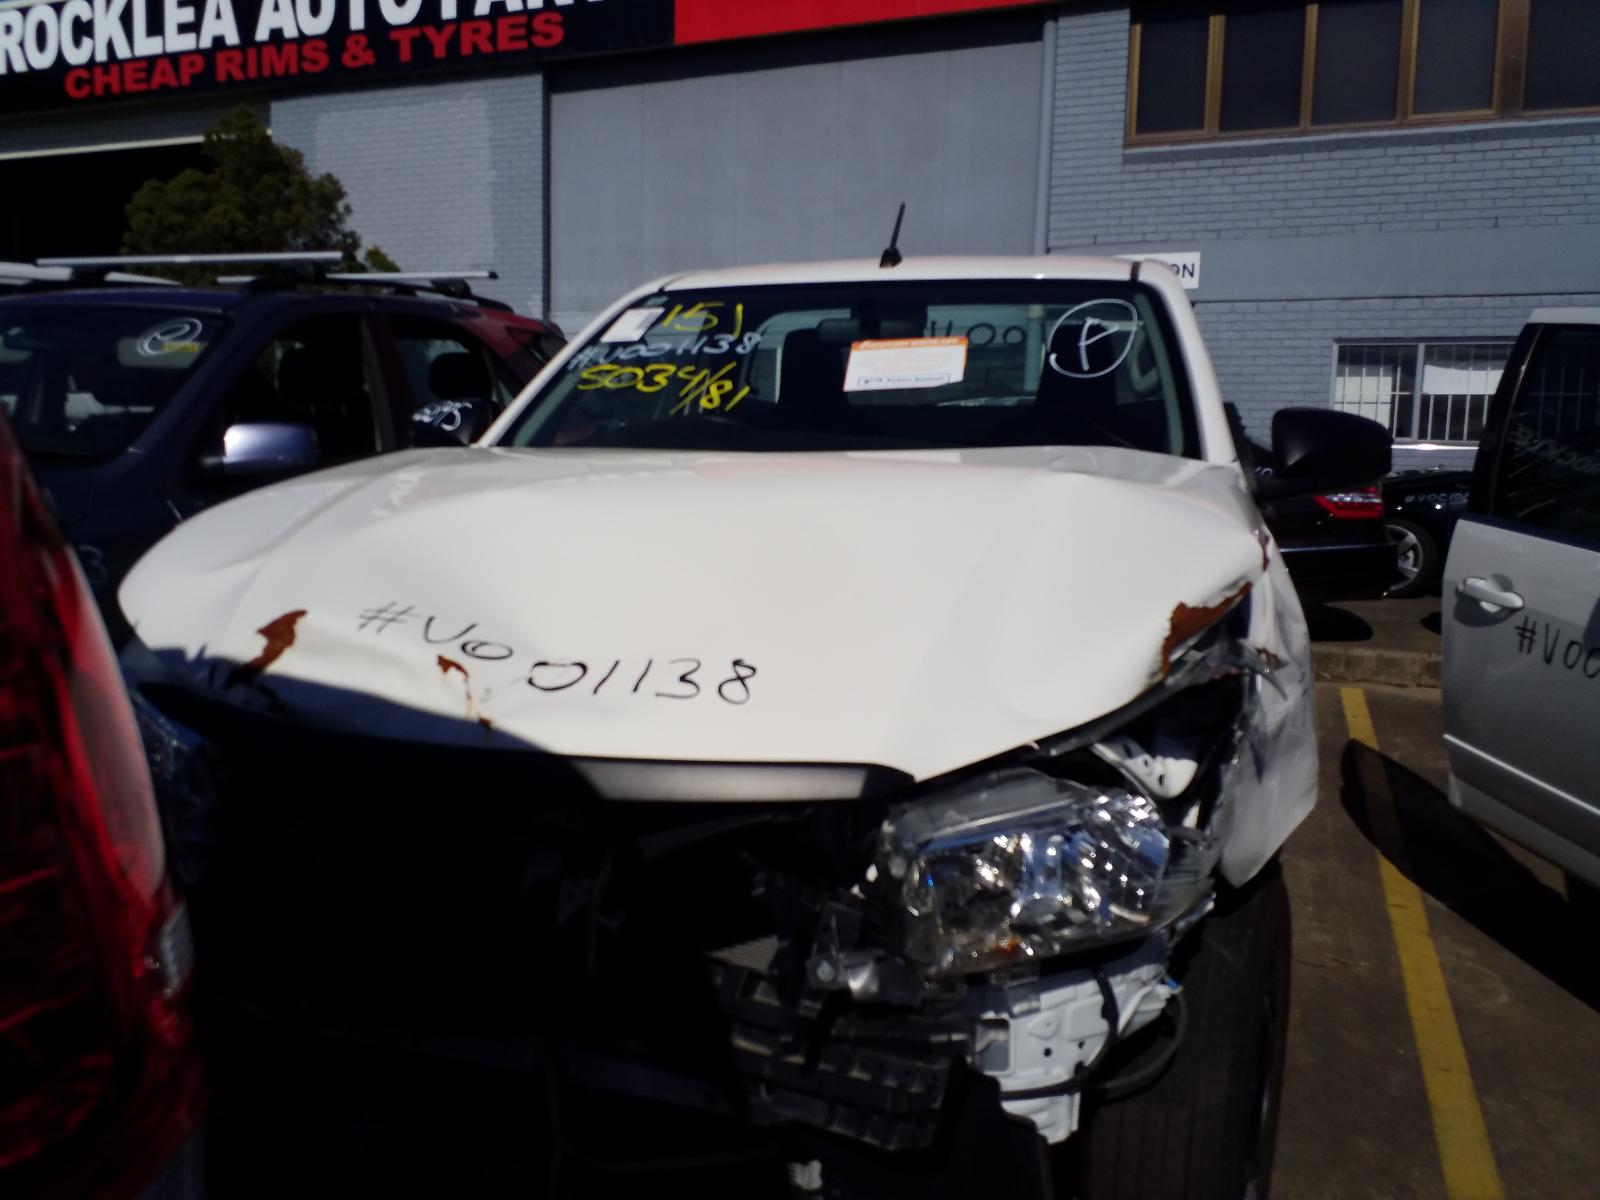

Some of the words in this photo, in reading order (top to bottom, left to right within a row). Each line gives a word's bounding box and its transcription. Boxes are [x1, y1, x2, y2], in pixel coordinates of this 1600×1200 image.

[0, 0, 240, 74] ROCKLEA
[64, 53, 205, 98] CHEAP
[215, 39, 330, 82] RIMS
[341, 34, 376, 68] &
[389, 11, 564, 63] TYRES
